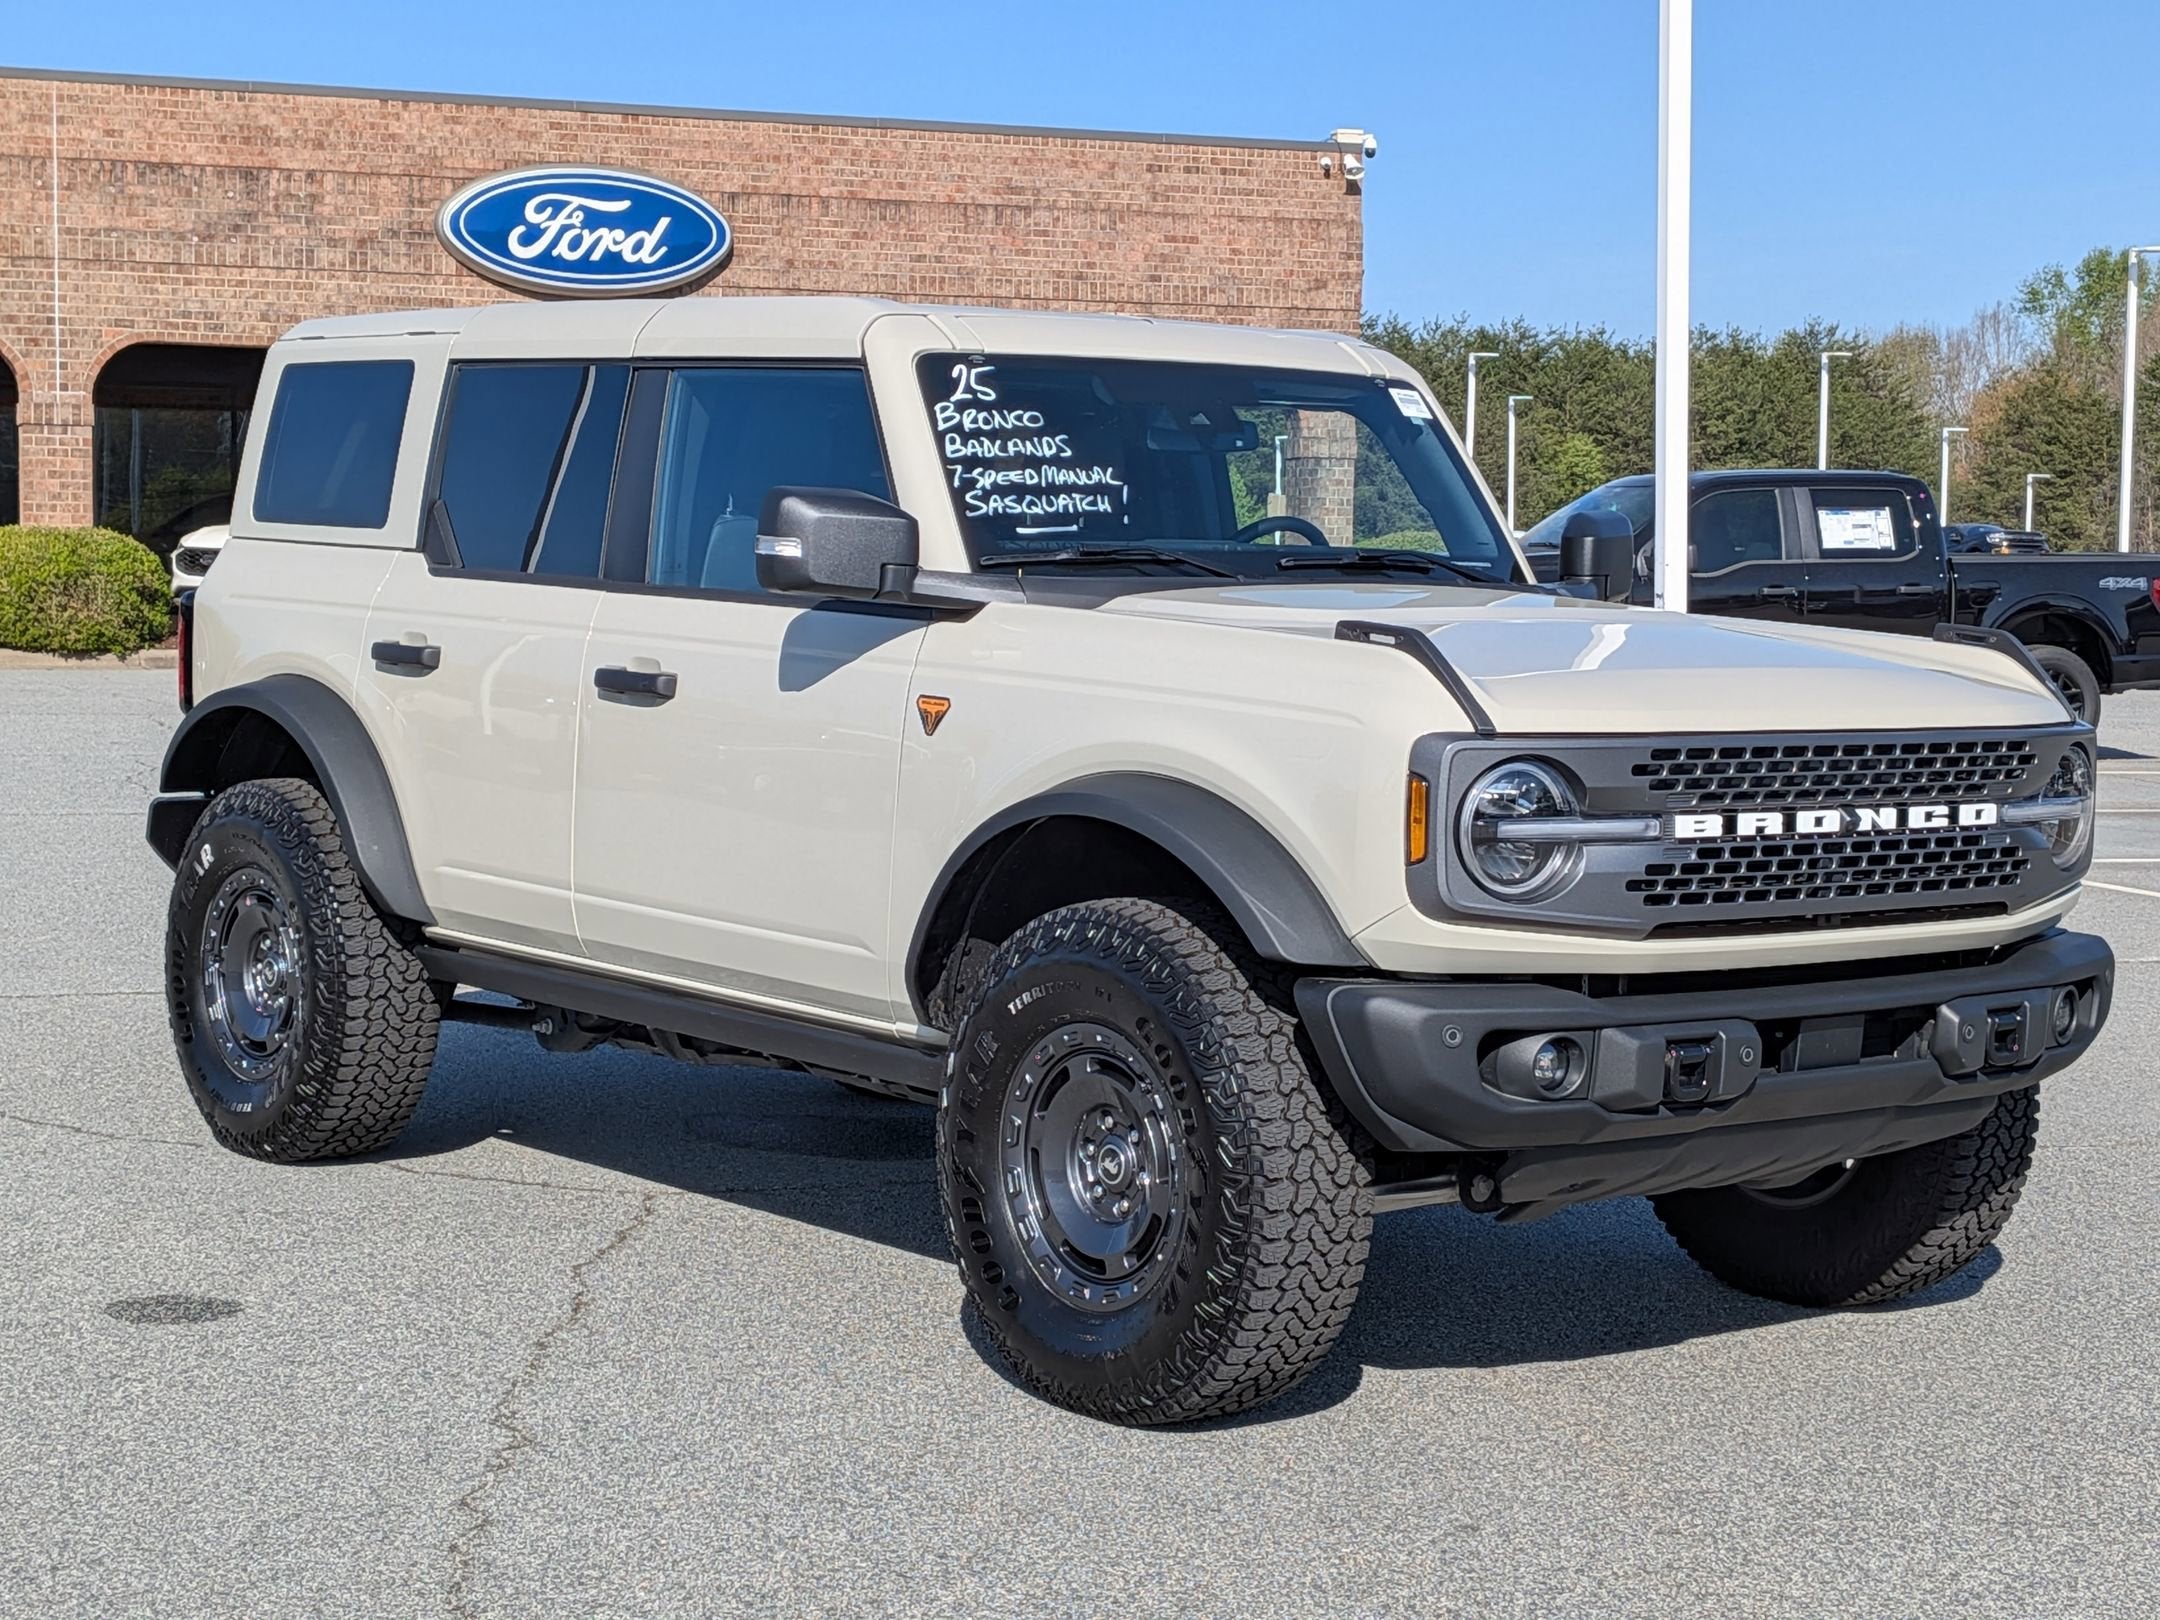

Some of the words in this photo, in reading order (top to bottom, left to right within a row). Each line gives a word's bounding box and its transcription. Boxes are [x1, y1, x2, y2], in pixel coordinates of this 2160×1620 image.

[508, 193, 671, 264] Ford
[950, 364, 996, 402] 25
[934, 402, 1045, 432] BRONCO
[945, 433, 1072, 458] BADLANDS
[947, 465, 1039, 490] 7-SPEED
[1041, 465, 1123, 487] MANUAL
[1674, 803, 1998, 839] BRONCO
